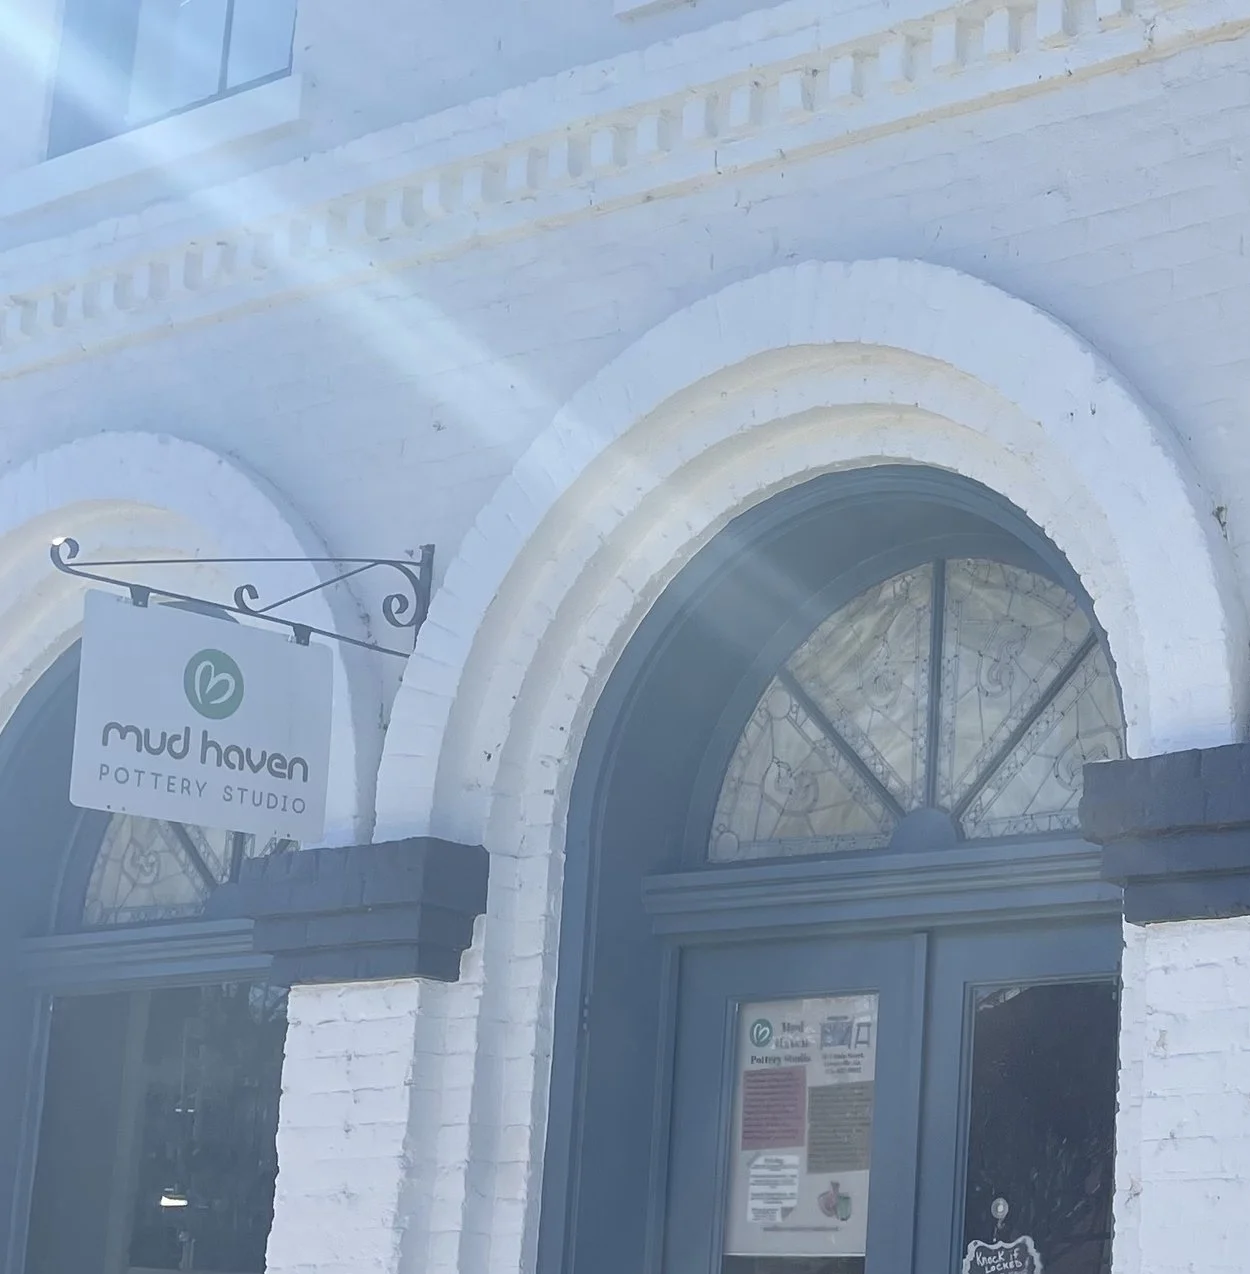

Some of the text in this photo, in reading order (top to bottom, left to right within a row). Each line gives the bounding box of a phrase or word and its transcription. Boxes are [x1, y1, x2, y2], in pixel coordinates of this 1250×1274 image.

[102, 721, 309, 783] mud haven
[98, 763, 307, 815] POTTERY STUDIO
[985, 1260, 1022, 1274] LOCKED
